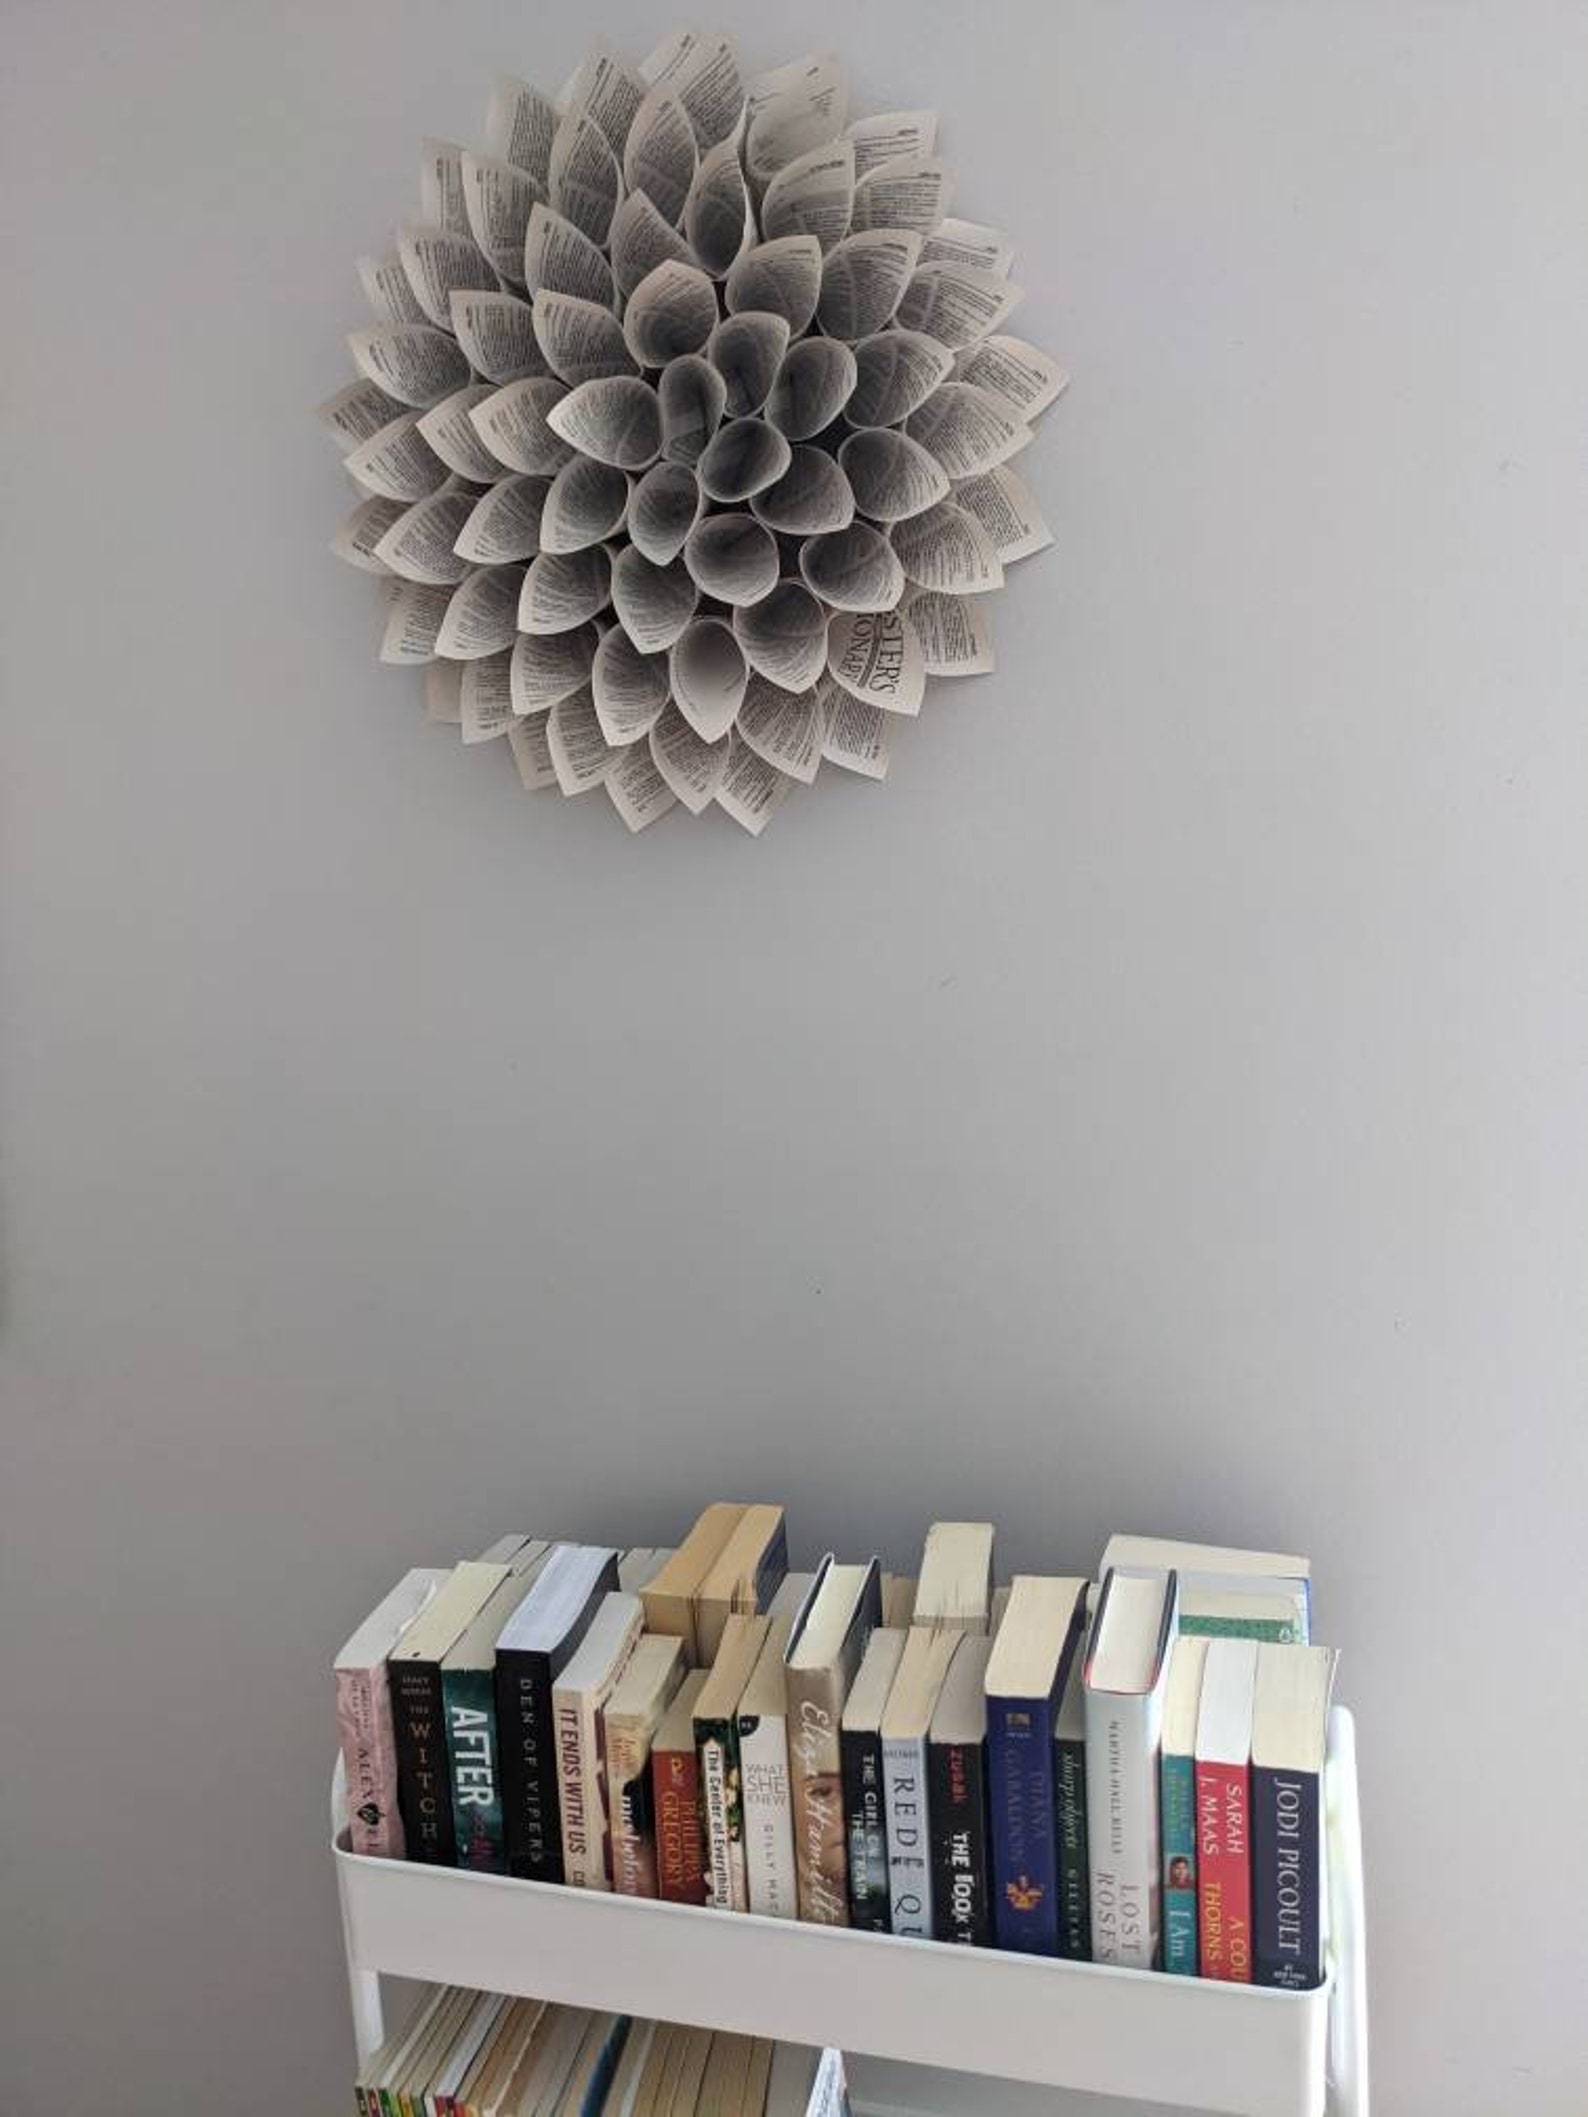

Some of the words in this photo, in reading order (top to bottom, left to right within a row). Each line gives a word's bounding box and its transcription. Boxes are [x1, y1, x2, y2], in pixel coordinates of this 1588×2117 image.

[520, 1678, 534, 1724] DEN
[559, 1707, 578, 1723] IT
[451, 1706, 496, 1807] AFTER
[522, 1739, 537, 1765] OF
[561, 1729, 581, 1777] ENDS
[706, 1750, 720, 1770] The
[745, 1762, 785, 1775] WHAT
[862, 1752, 875, 1784] THE
[409, 1722, 438, 1840] WITCH
[564, 1781, 586, 1829] WITH
[746, 1775, 787, 1794] SHE
[747, 1794, 787, 1806] KNEW
[1030, 1770, 1047, 1839] DIANA
[526, 1781, 543, 1863] VIPERS
[713, 1821, 726, 1836] of
[850, 1811, 865, 1840] THE
[865, 1791, 878, 1827] GIRL
[893, 1776, 919, 1848] RED
[1201, 1797, 1219, 1855] MAAS
[1226, 1783, 1244, 1853] SARAH
[1274, 1777, 1302, 1838] JODI
[567, 1831, 587, 1855] US
[661, 1791, 686, 1889] GREGORY
[951, 1831, 971, 1867] THE
[714, 1839, 729, 1904] Everything
[853, 1849, 868, 1900] TRAIN
[1097, 1872, 1118, 1960] ROSES
[1120, 1884, 1142, 1953] LOST
[1169, 1910, 1191, 1920] I
[1204, 1881, 1223, 1961] THORNS
[1228, 1917, 1245, 1931] A
[1278, 1850, 1302, 1954] PICOULT
[1171, 1923, 1189, 1957] Am
